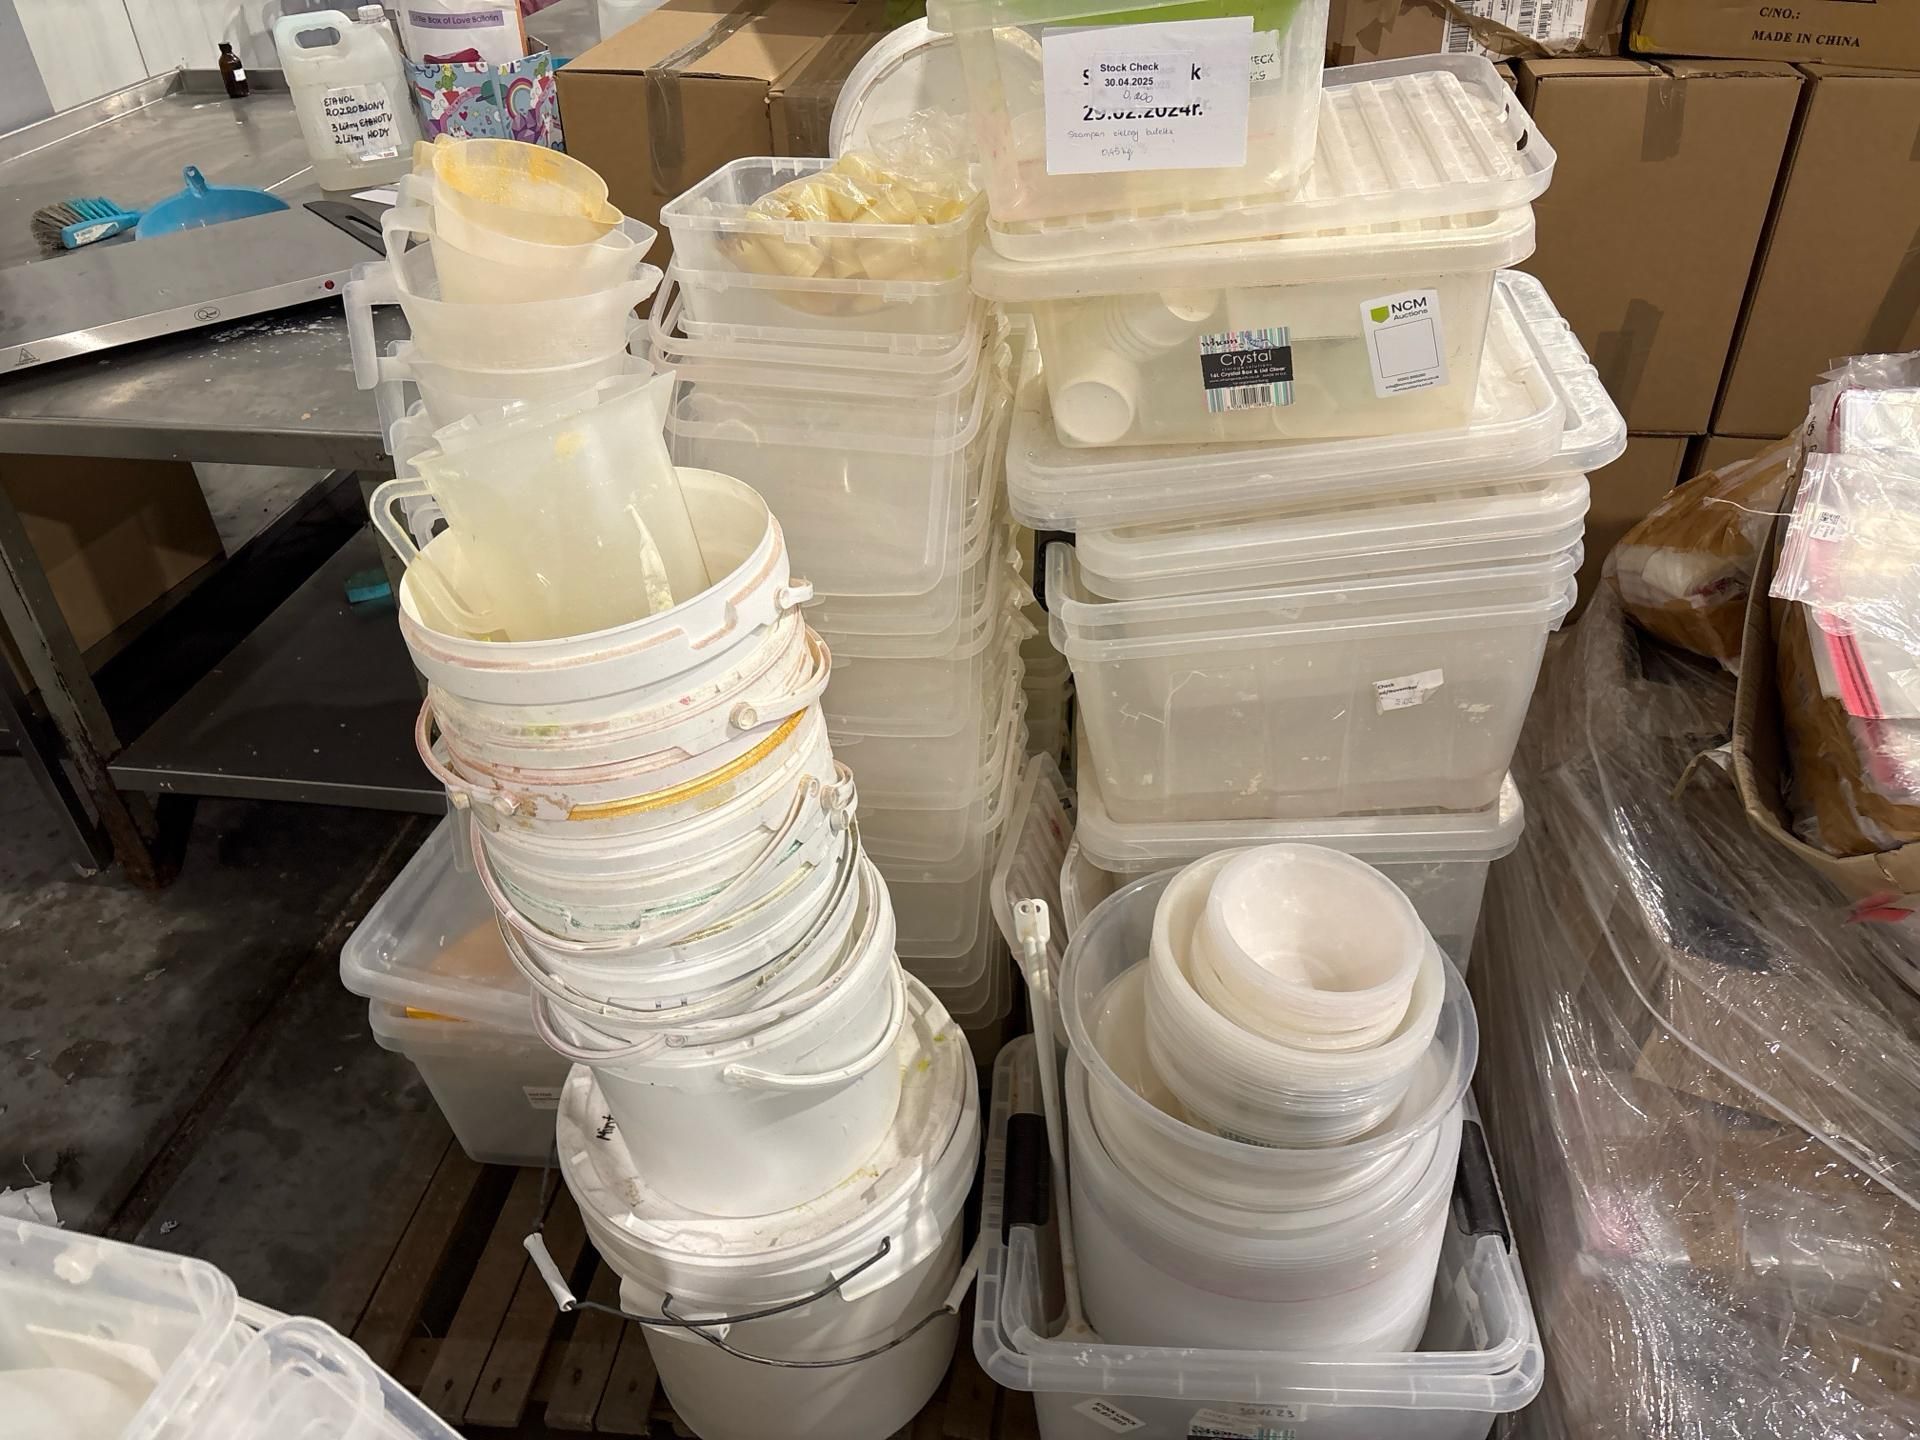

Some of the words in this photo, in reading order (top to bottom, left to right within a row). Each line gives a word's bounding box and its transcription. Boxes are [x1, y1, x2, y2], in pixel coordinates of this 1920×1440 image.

[1760, 7, 1800, 19] C/NO.:
[452, 17, 471, 25] Love
[1752, 30, 1792, 42] MADE
[1796, 33, 1812, 43] IN
[1816, 35, 1860, 47] CHINA
[1100, 64, 1127, 72] Stock
[1129, 62, 1159, 72] Check
[1105, 77, 1154, 87] 30.04.2025
[331, 123, 338, 133] 3
[335, 134, 343, 144] 2
[1391, 296, 1428, 314] NCM
[1393, 309, 1429, 321] Auctions
[1220, 350, 1272, 366] Crystal
